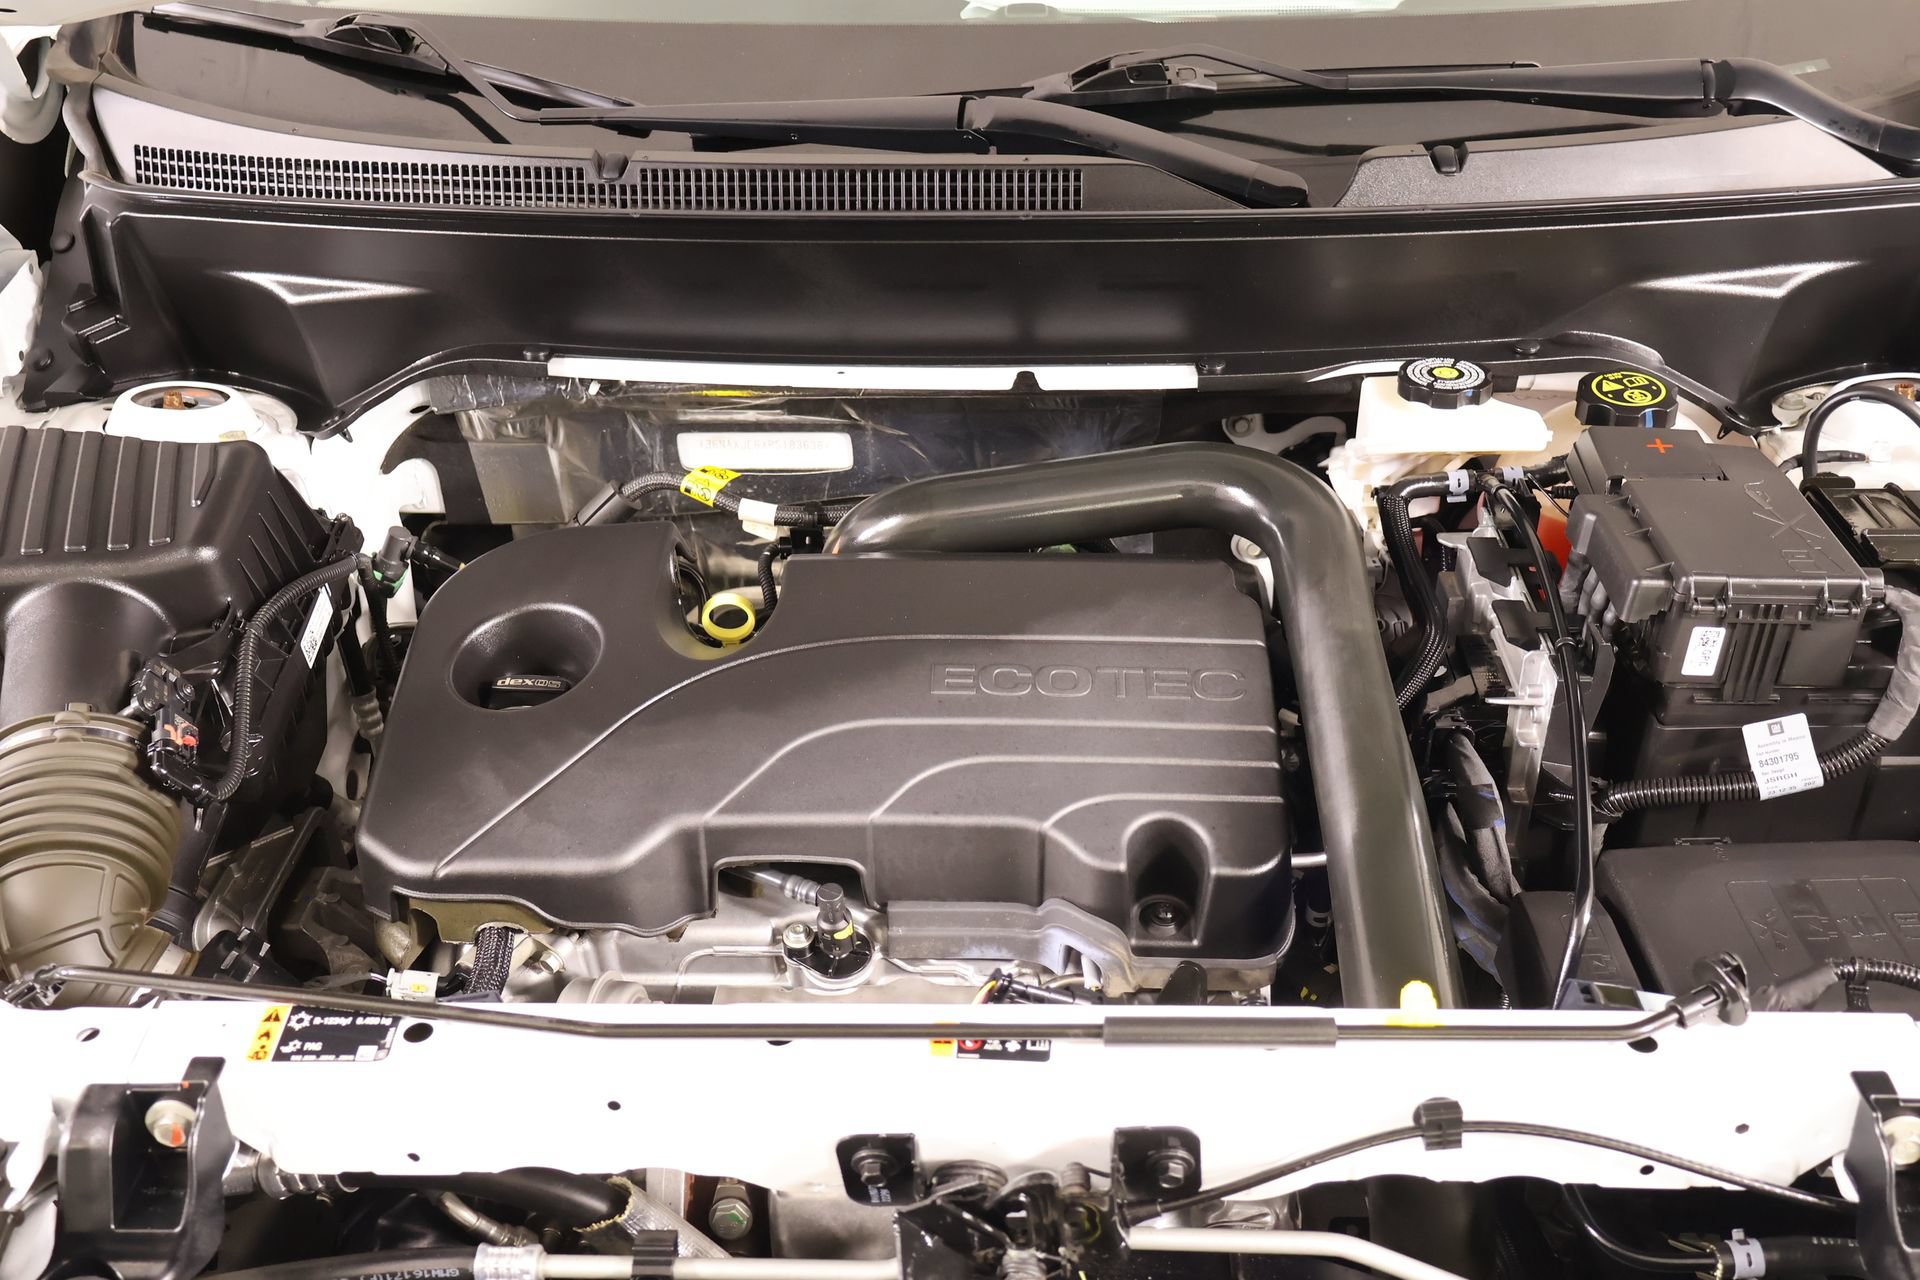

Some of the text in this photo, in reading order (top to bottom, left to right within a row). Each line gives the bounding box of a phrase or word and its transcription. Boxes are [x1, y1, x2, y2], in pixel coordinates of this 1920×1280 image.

[496, 677, 562, 689] dexos
[930, 663, 1247, 701] ECOTEC
[1758, 752, 1800, 768] 84301795
